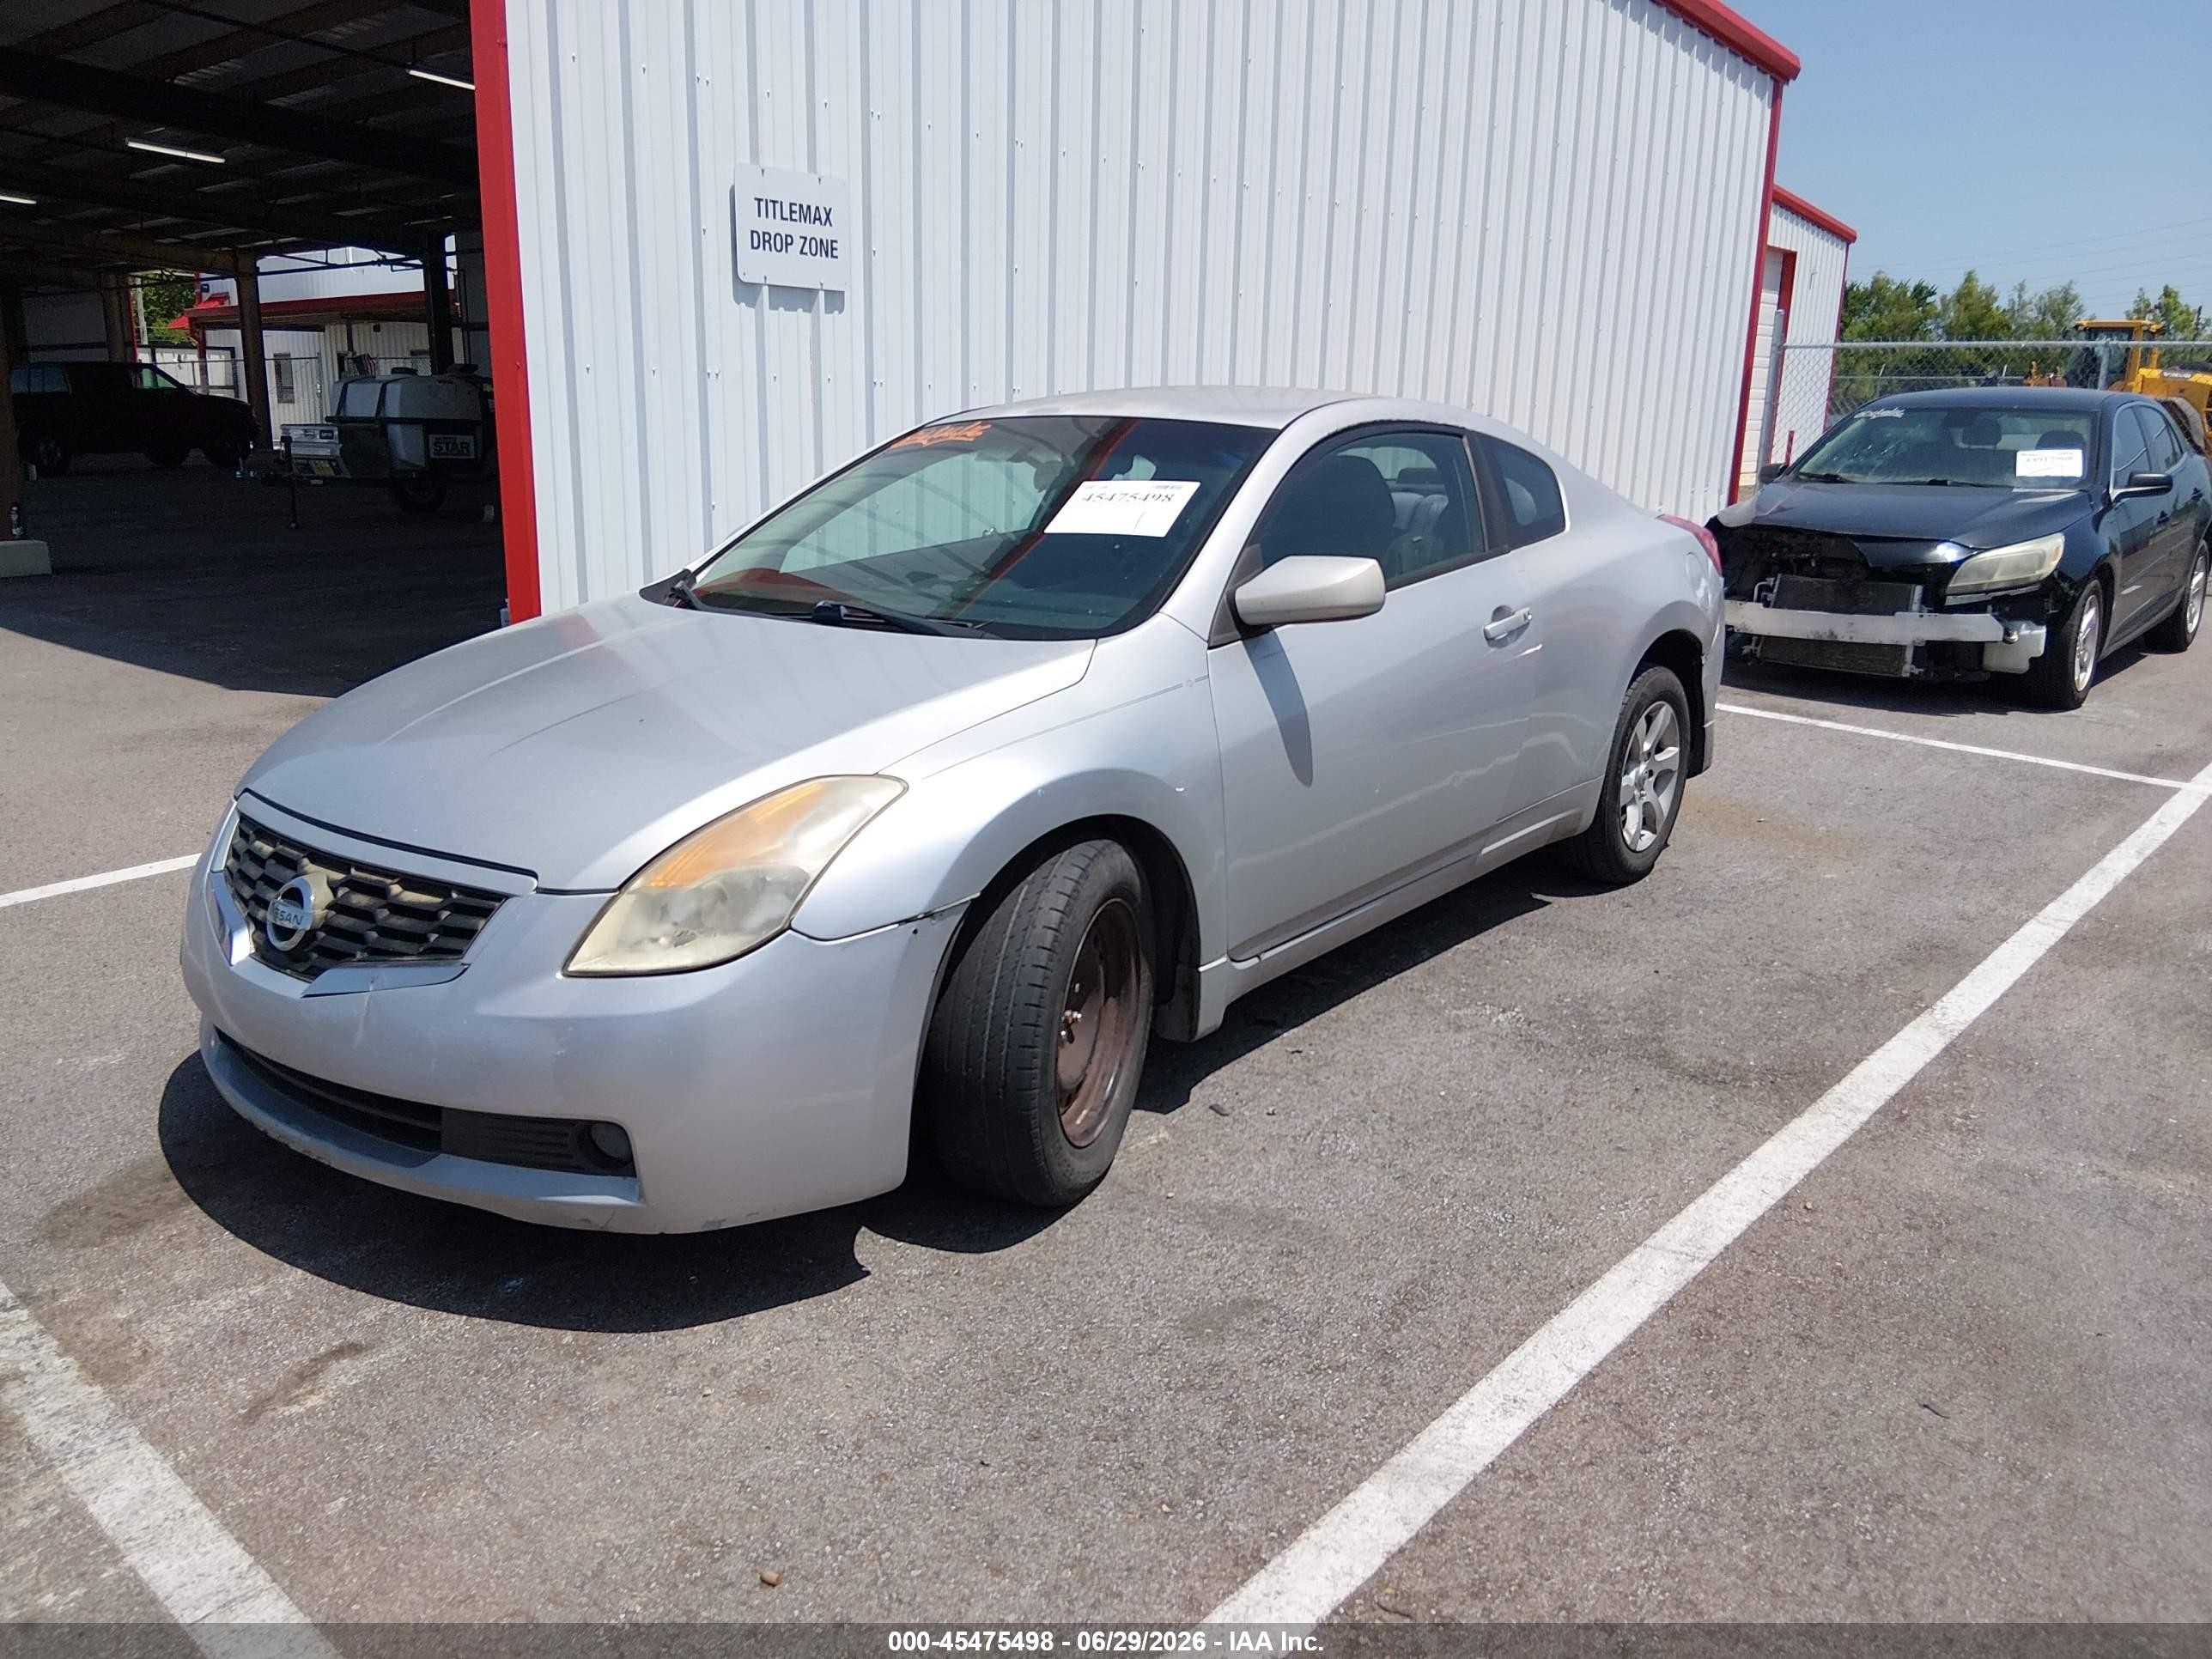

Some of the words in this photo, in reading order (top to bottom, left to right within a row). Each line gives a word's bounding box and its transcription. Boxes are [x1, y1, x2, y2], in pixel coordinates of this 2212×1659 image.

[754, 197, 833, 228] TITLEMAX
[750, 229, 794, 253] DROP
[799, 235, 839, 259] ZONE
[434, 441, 470, 453] STAR
[1082, 493, 1175, 502] 45475498
